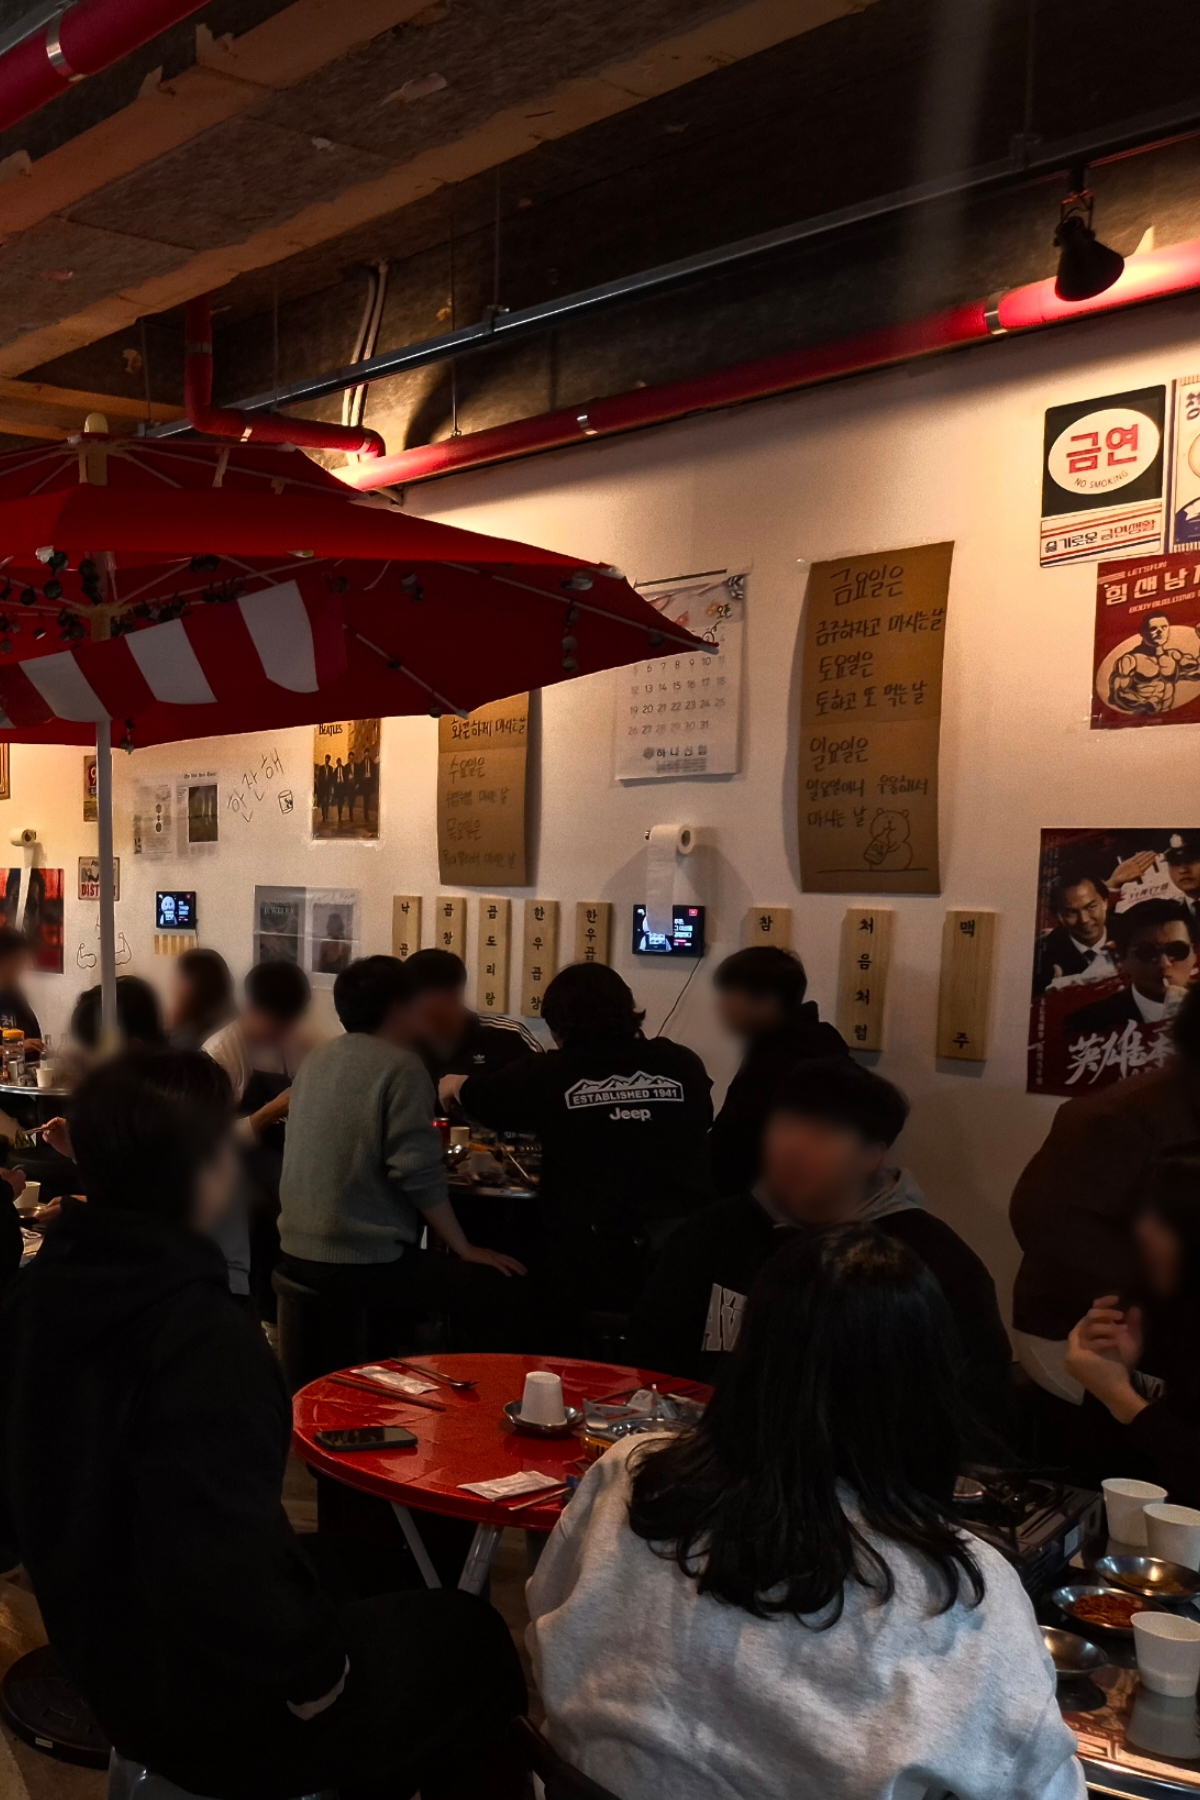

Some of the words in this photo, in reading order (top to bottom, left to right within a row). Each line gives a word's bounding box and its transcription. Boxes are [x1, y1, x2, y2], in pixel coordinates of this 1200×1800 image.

[1066, 423, 1139, 474] 금연
[1074, 477, 1087, 488] NO
[1089, 469, 1129, 489] SMOKING
[1101, 519, 1157, 541] 금연생활
[829, 564, 904, 606] 금요일은
[661, 662, 667, 670] 7
[675, 660, 680, 670] 8
[702, 657, 711, 666] 10
[819, 651, 874, 683] 토요일은
[645, 684, 653, 693] 13
[659, 683, 667, 691] 14
[673, 682, 681, 690] 15
[687, 680, 696, 689] 16
[702, 677, 711, 687] 17
[630, 706, 638, 716] 19
[642, 704, 654, 714] 20
[657, 703, 667, 713] 21
[670, 701, 681, 711] 22
[685, 700, 696, 710] 23
[700, 699, 711, 709] 24
[815, 689, 857, 717] 토하고
[864, 686, 877, 708] 또
[884, 683, 909, 708] 먹는
[912, 680, 928, 705] 날
[319, 723, 343, 737] BEATLES
[450, 719, 492, 740] 화끈하게
[641, 725, 652, 734] 27
[700, 720, 709, 730] 31
[809, 735, 869, 772] 일요일은
[448, 755, 486, 784] 수요일은
[876, 773, 929, 796] 우울해서
[853, 805, 868, 829] 날
[446, 817, 482, 841] 목요일은
[531, 905, 546, 1011] 한우곱창
[854, 916, 875, 1042] 처음처럼
[573, 1089, 650, 1106] ESTABLISHED
[652, 1087, 678, 1099] 1941
[609, 1106, 652, 1122] Jeep
